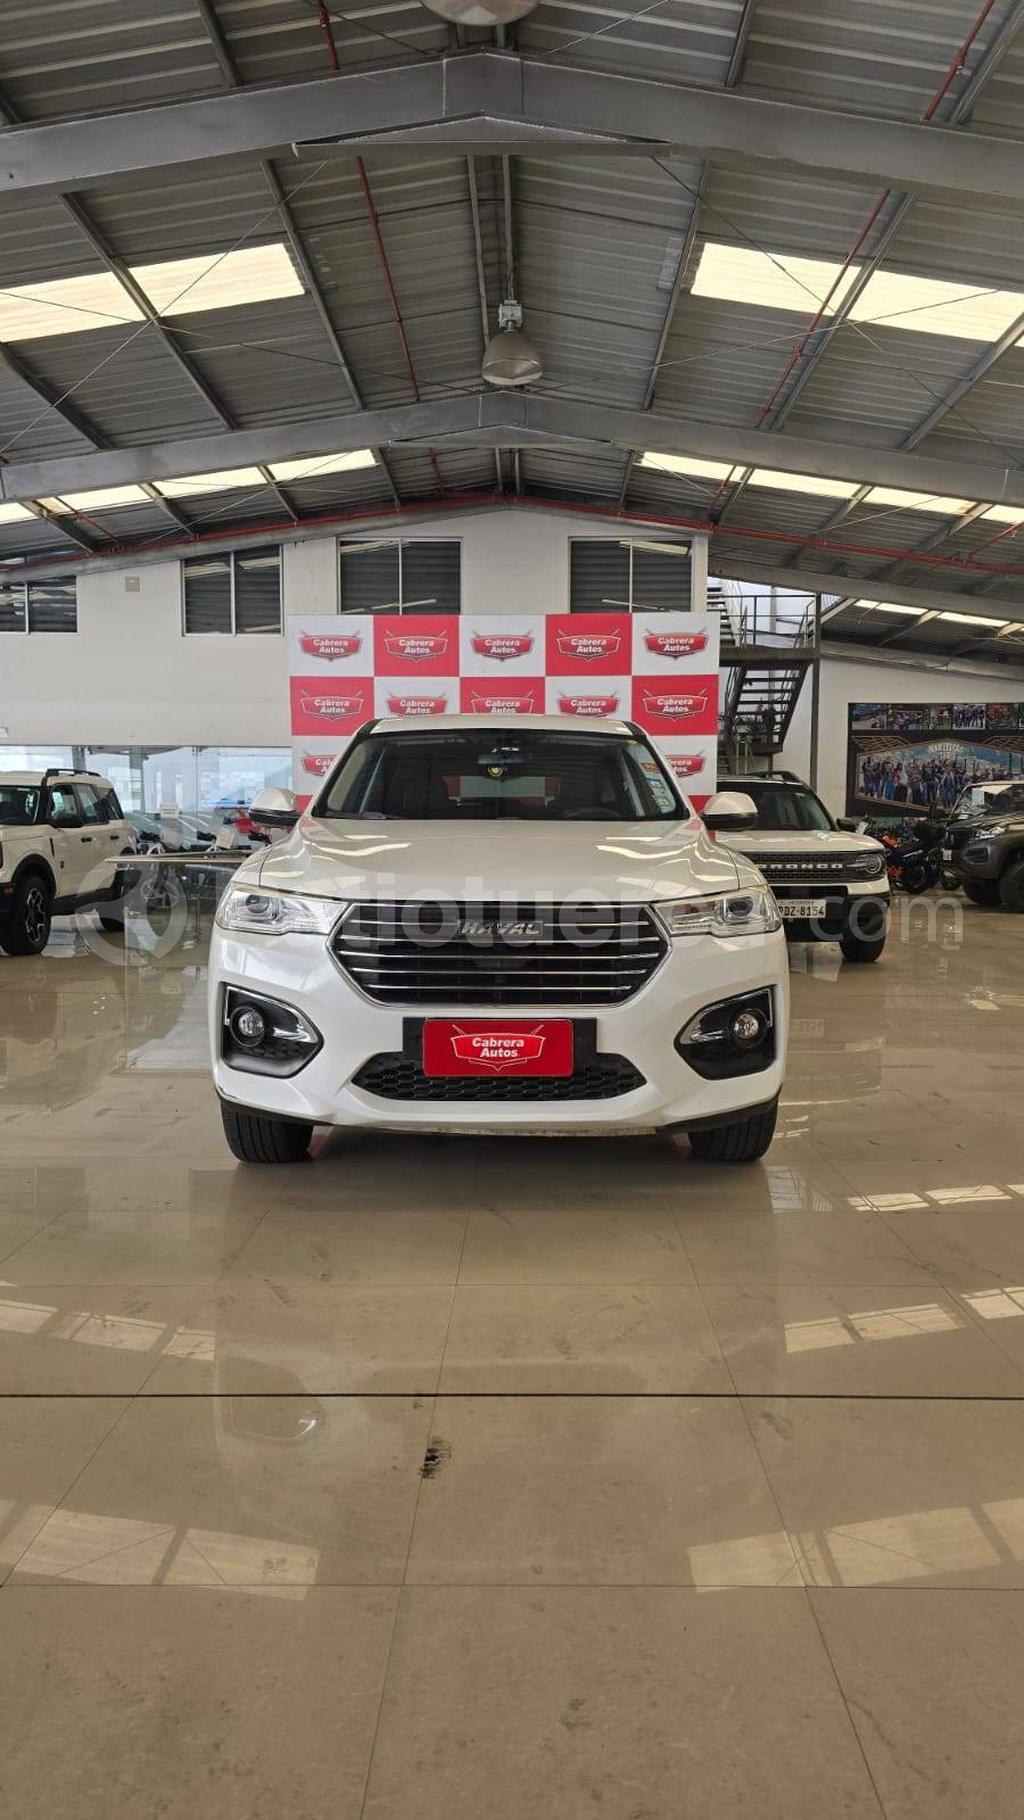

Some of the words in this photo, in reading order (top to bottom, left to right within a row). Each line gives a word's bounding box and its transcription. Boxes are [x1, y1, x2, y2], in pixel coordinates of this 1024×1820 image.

[313, 639, 349, 647] Cabrera
[398, 639, 434, 647] Cabrera
[484, 639, 520, 647] Cabrera
[570, 638, 606, 646] Cabrera
[657, 637, 694, 645] Cabrera
[319, 646, 345, 654] Autos
[404, 646, 430, 654] Autos
[490, 646, 516, 654] Autos
[576, 645, 602, 653] Autos
[663, 644, 689, 652] Autos
[314, 699, 350, 707] Cabrera
[657, 698, 693, 706] Cabrera
[320, 706, 346, 714] Autos
[663, 705, 688, 713] Autos
[778, 905, 824, 916] PDZ-8154
[461, 921, 540, 934] HAVAL
[471, 1037, 525, 1048] Cabrera
[480, 1047, 518, 1058] Autos
